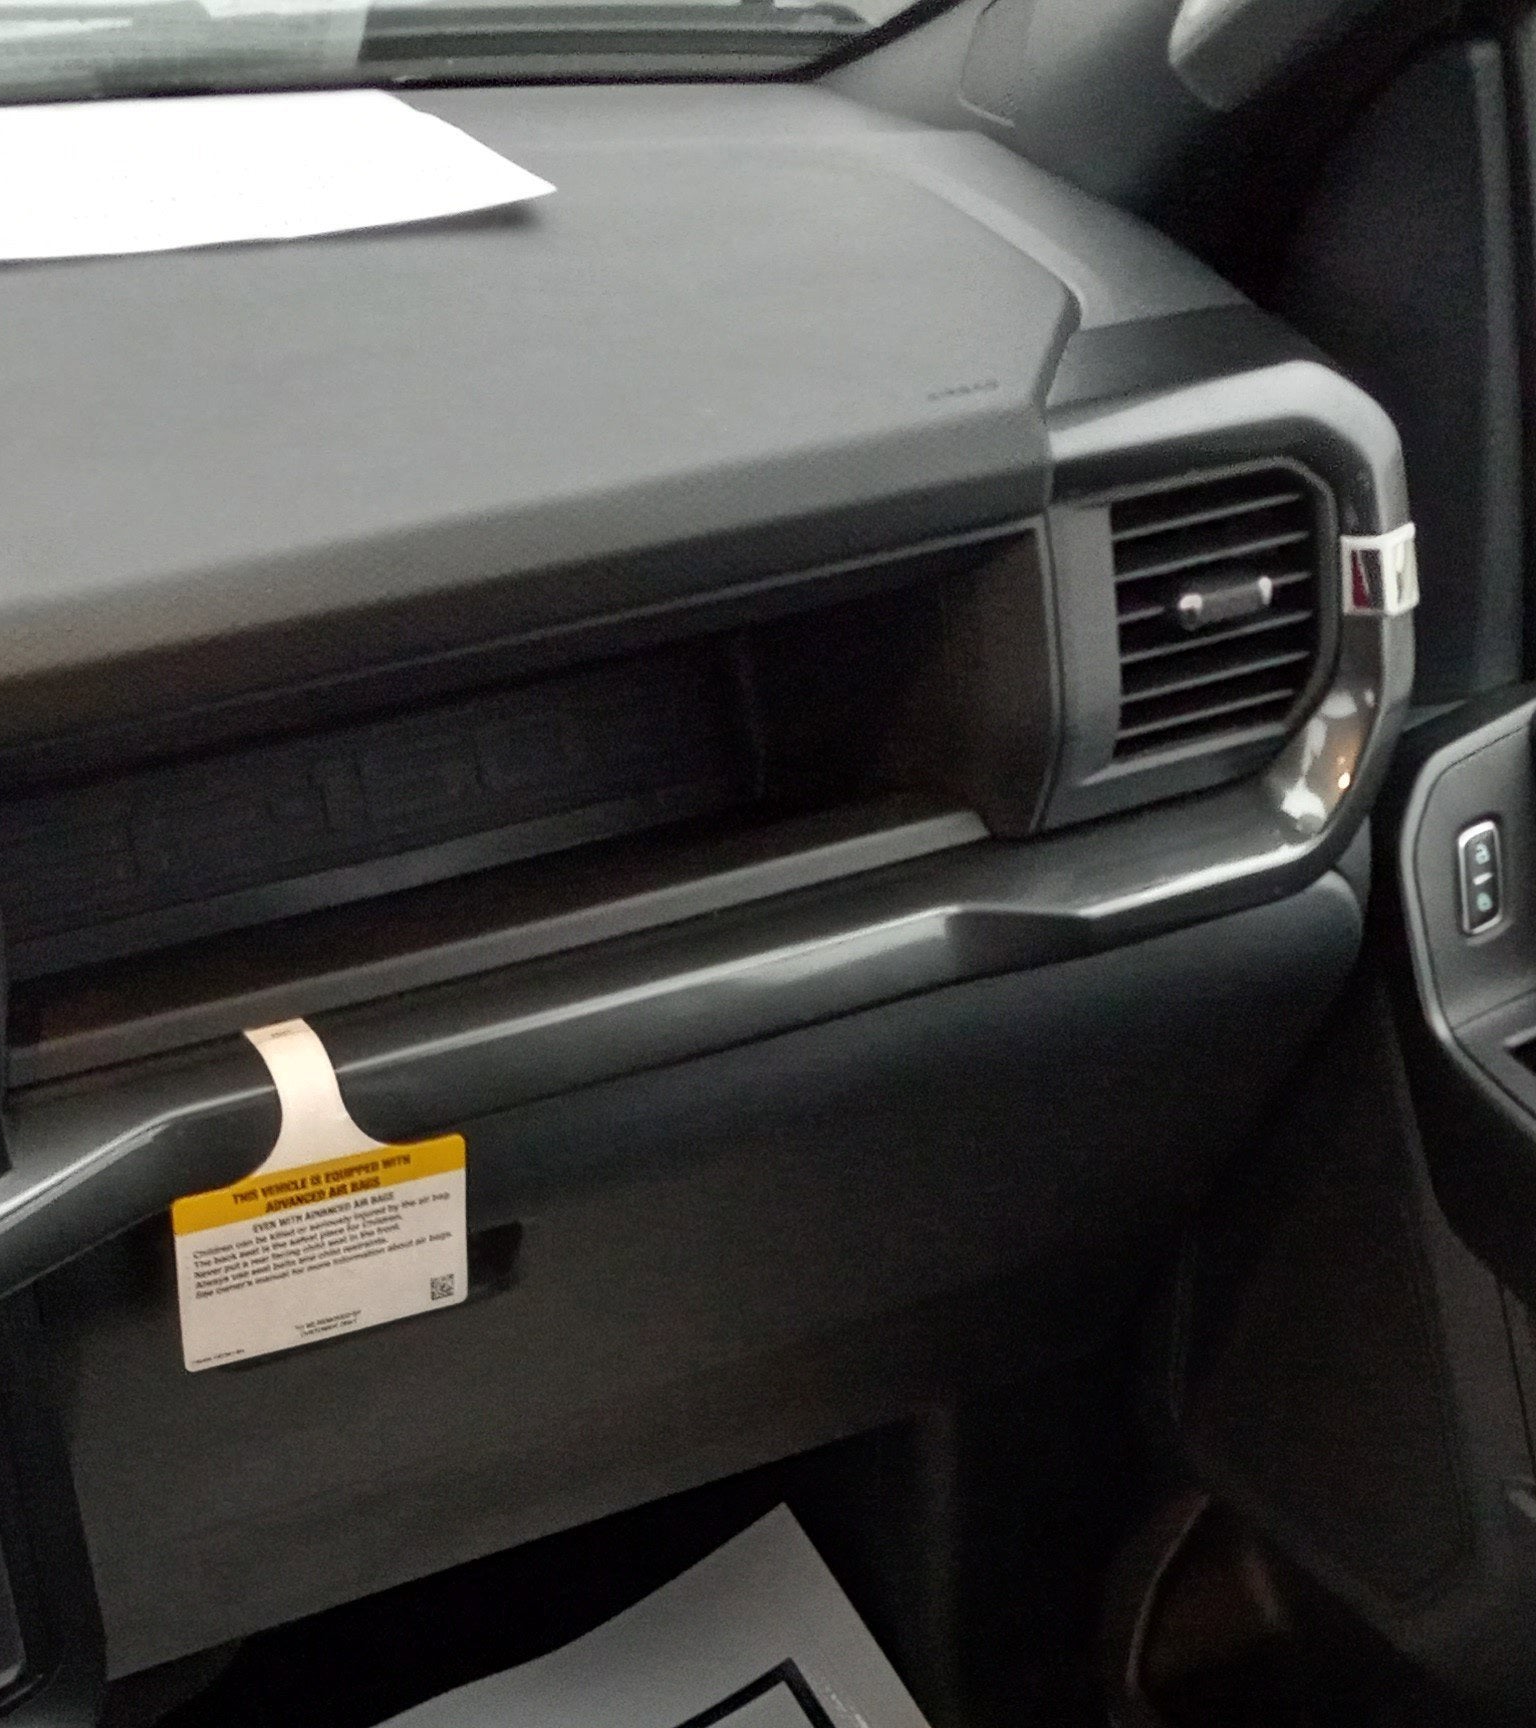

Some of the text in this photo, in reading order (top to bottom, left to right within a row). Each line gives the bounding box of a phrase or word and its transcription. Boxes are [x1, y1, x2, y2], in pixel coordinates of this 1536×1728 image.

[232, 1152, 411, 1205] THIS VEHICLE IS EQUIPPED WITH
[263, 1175, 380, 1213] ADVANCED AIR BAGS
[251, 1191, 394, 1233] EVEN WITH ADVANCED AIR BAGS
